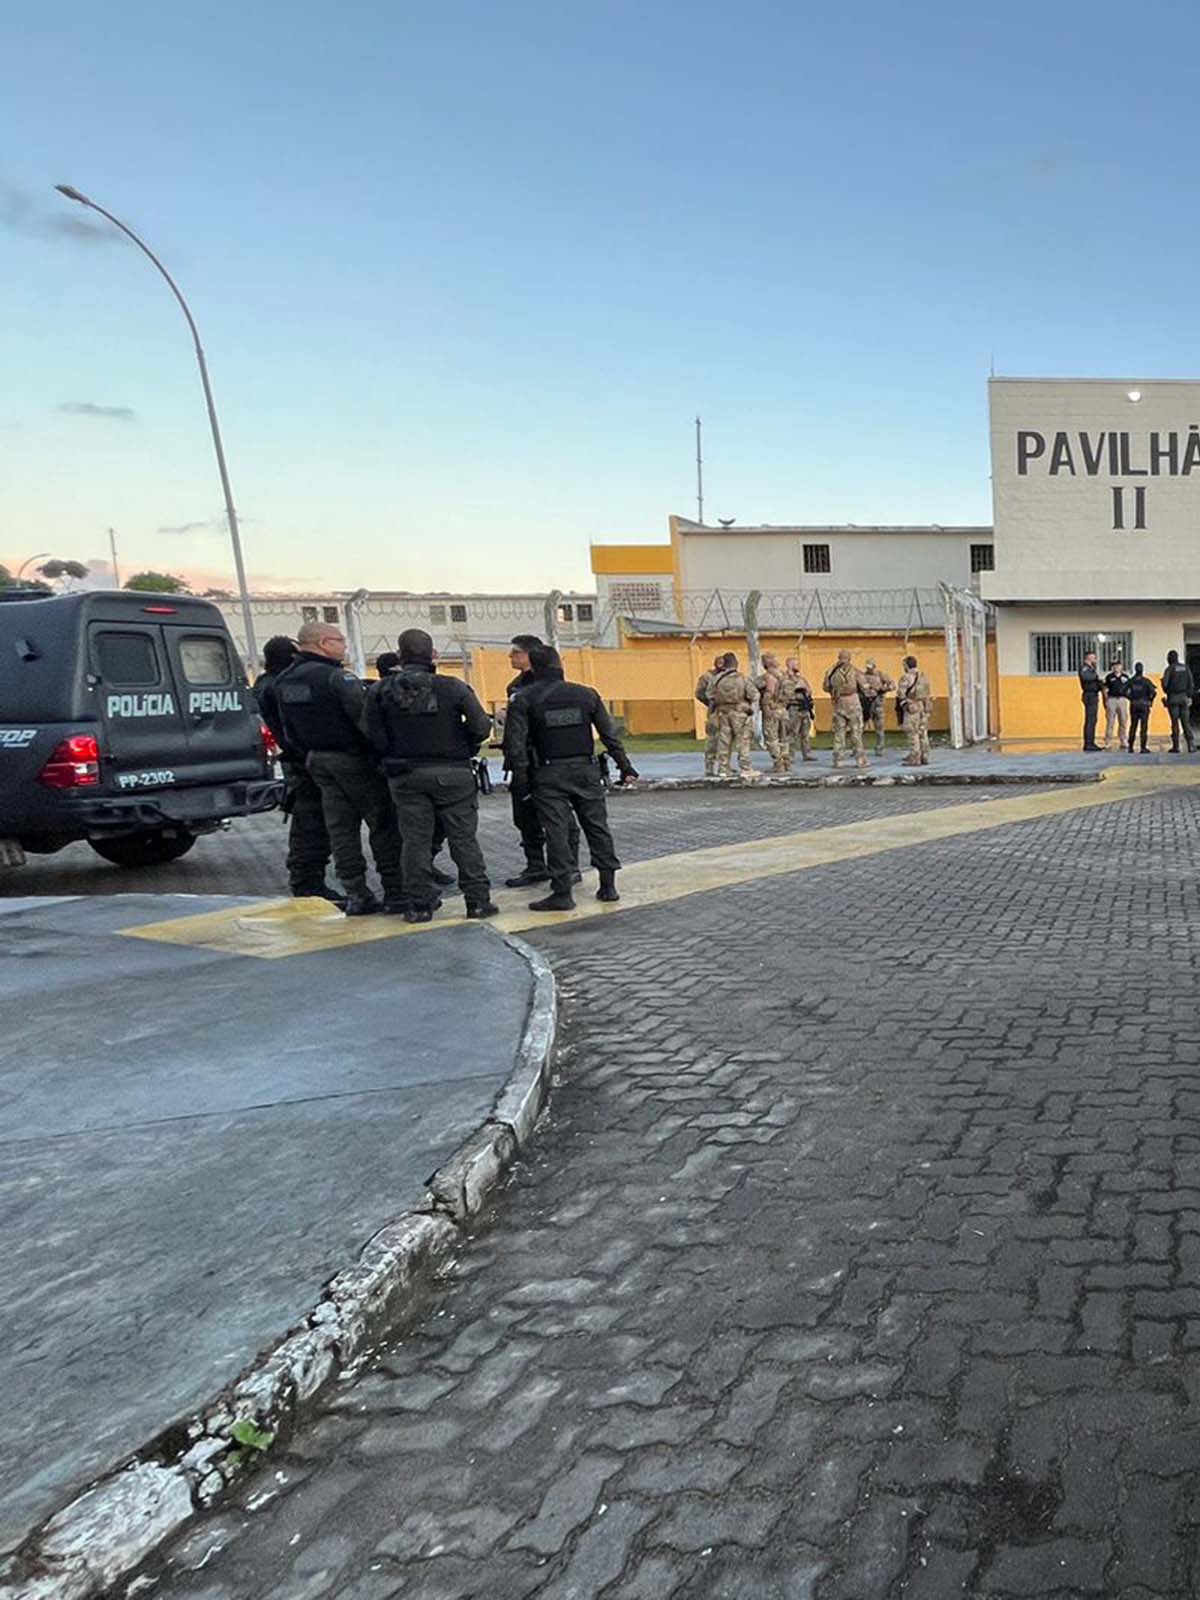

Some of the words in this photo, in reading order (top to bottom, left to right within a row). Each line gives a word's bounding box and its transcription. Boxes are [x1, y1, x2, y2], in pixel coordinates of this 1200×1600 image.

[1112, 486, 1147, 530] II
[107, 694, 174, 718] POLÍCIA
[189, 692, 242, 713] PENAL
[119, 770, 175, 788] PP-2302
